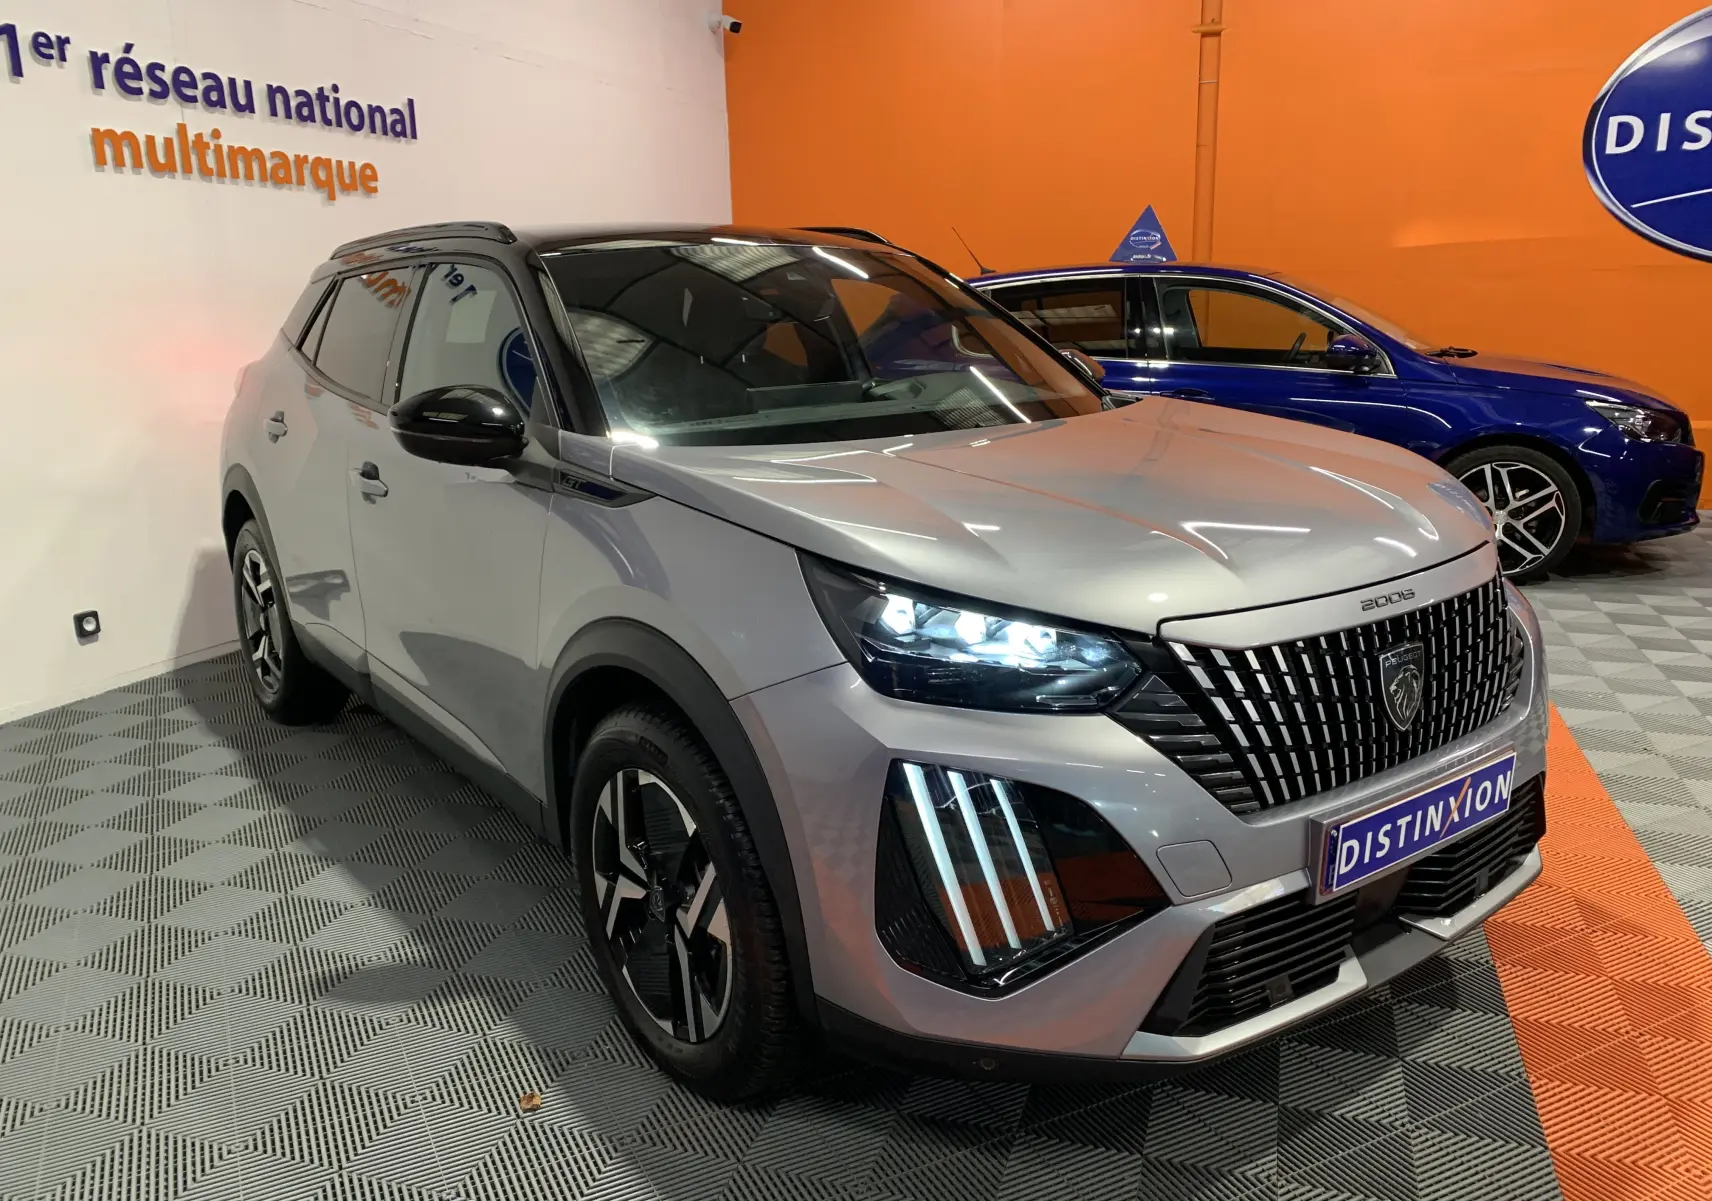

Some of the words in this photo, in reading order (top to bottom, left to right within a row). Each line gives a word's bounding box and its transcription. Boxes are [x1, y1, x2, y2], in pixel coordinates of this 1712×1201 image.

[88, 42, 256, 115] réseau
[266, 83, 419, 140] national
[91, 122, 379, 202] multimarque
[1605, 109, 1712, 155] DIS
[1385, 650, 1422, 668] PEUGEOT
[1339, 770, 1512, 875] DISTINXION
